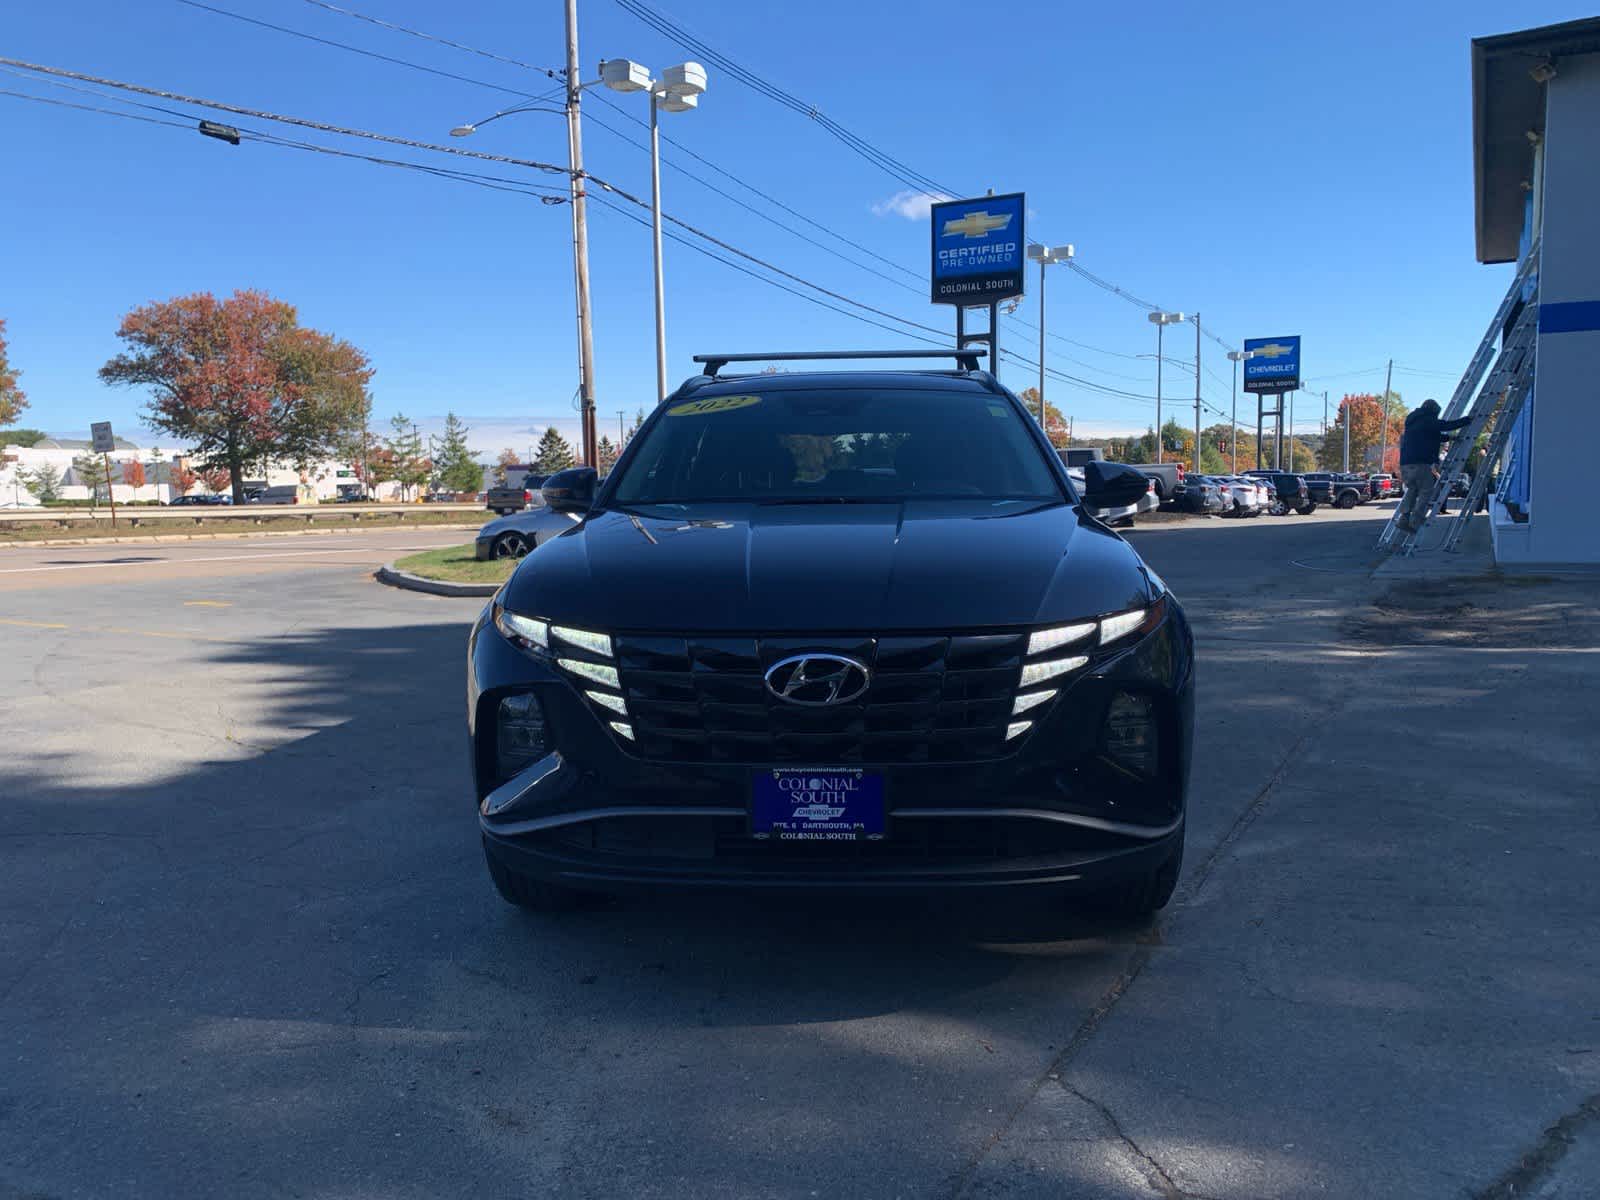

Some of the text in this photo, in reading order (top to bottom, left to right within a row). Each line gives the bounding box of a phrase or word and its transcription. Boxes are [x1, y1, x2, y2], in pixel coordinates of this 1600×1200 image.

[939, 242, 1016, 260] CERTIFIED
[968, 252, 1013, 265] OWNED
[940, 279, 1014, 294] COLONIAL SOUTH
[1248, 364, 1295, 374] CHEVROLET
[778, 777, 859, 791] COLONIAL
[791, 791, 846, 804] SOUTH
[780, 832, 857, 840] COLONIAL SOUTH
